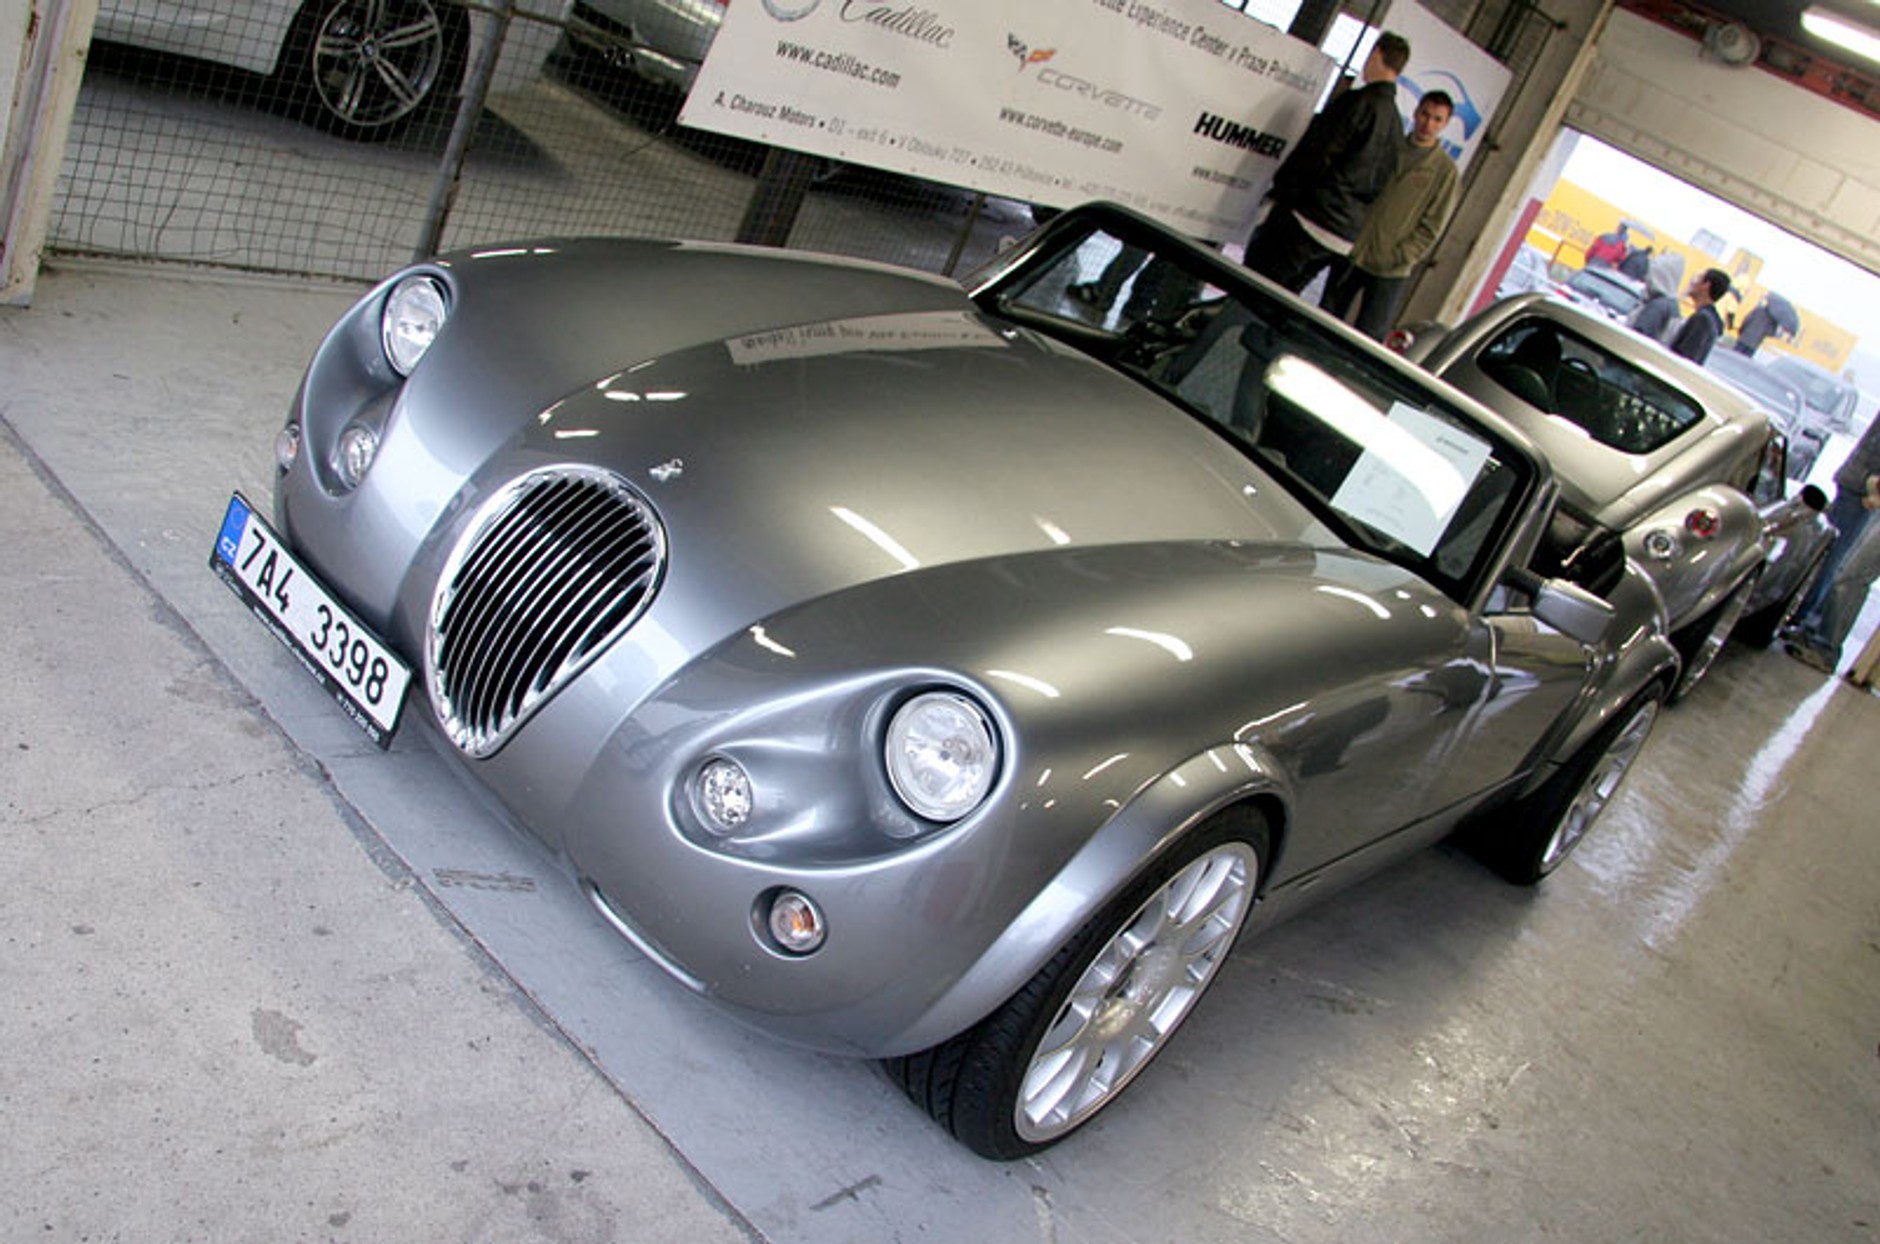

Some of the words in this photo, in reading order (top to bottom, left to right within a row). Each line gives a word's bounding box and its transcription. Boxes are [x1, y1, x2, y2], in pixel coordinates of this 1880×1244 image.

[1127, 2, 1192, 43] Experience
[1190, 26, 1229, 57] Center
[776, 40, 901, 88] www.cadillac.com
[780, 105, 816, 128] Motors
[1000, 106, 1123, 153] www.corvette-europe.com
[1193, 111, 1287, 159] HUMMER
[240, 528, 294, 613] 7A4
[310, 604, 389, 705] 3398
